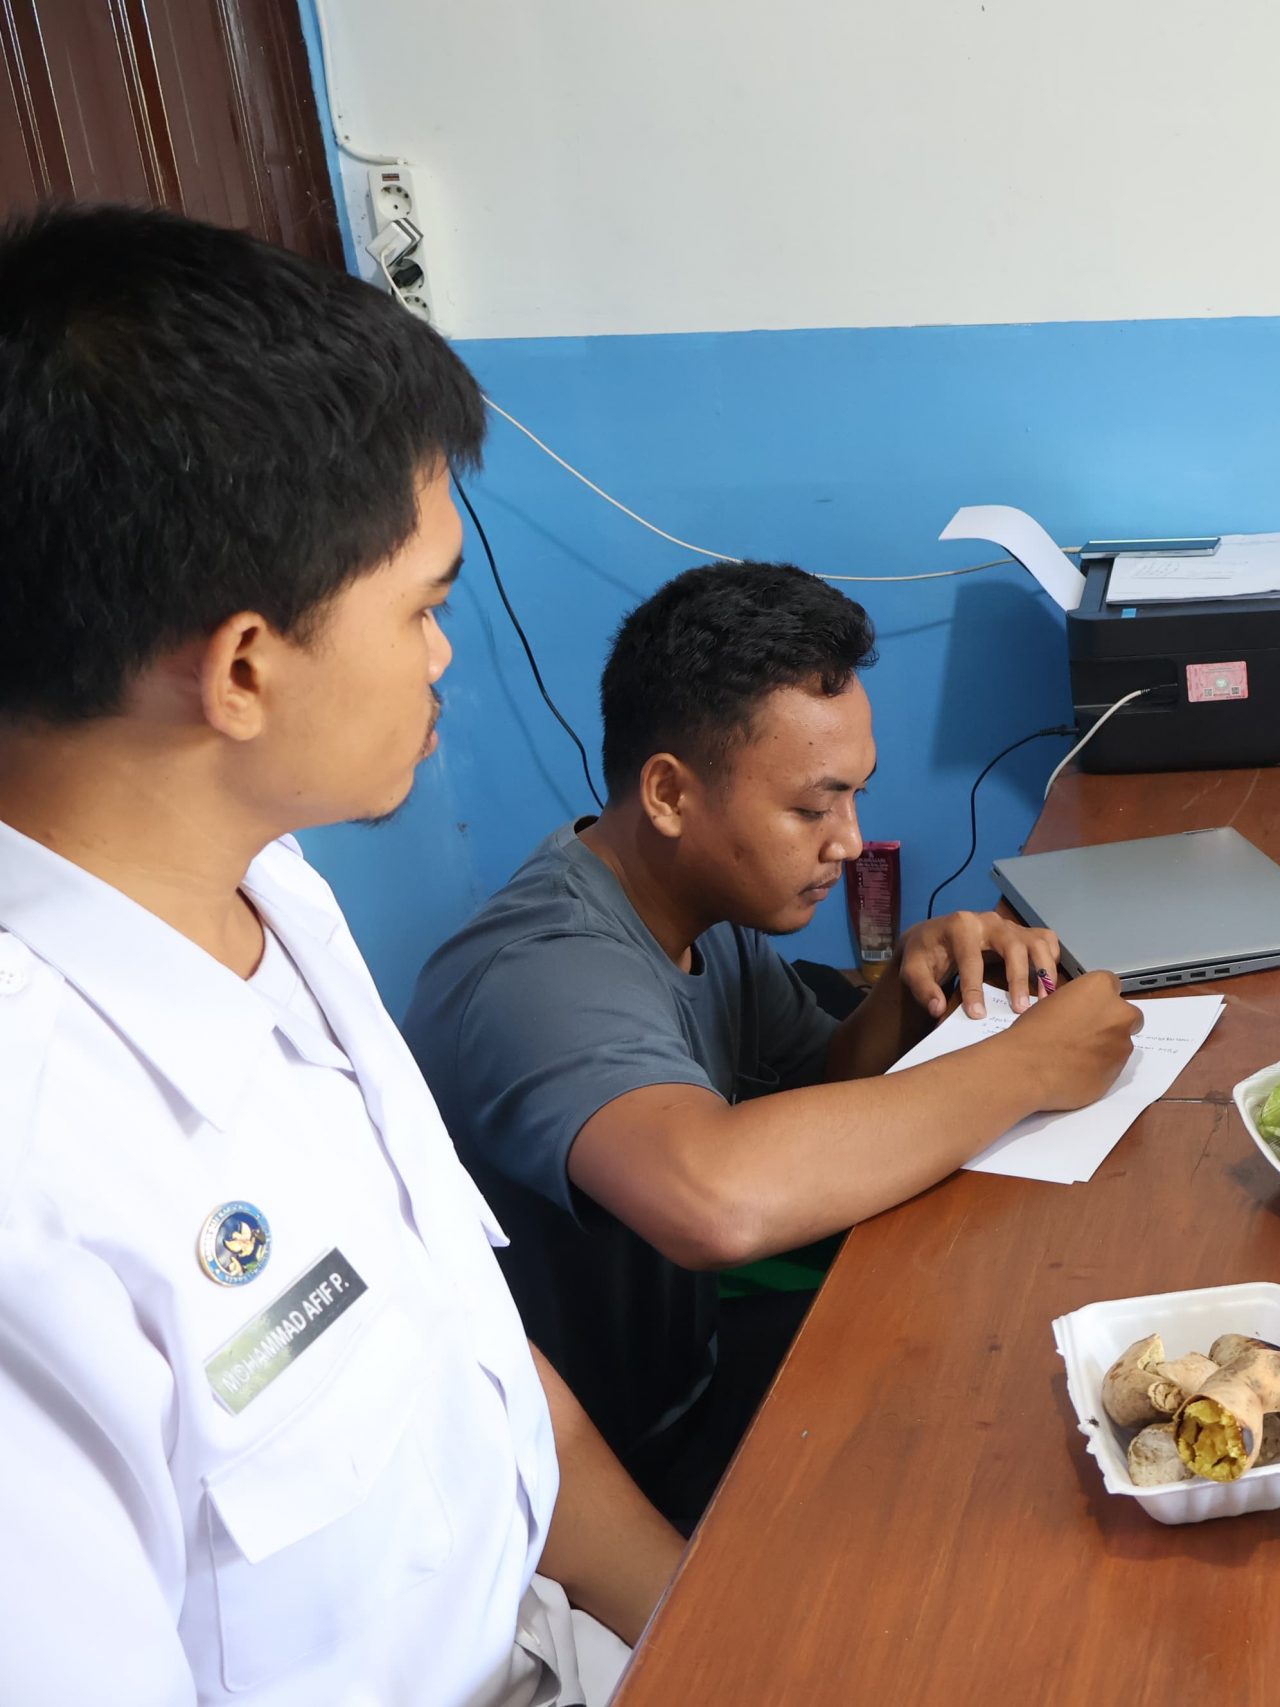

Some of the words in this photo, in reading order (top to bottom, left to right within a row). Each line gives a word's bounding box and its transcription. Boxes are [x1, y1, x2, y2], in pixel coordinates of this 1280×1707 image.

[221, 1310, 307, 1394] MOHAMMAD
[302, 1281, 335, 1321] AFIF
[329, 1272, 349, 1293] P.
